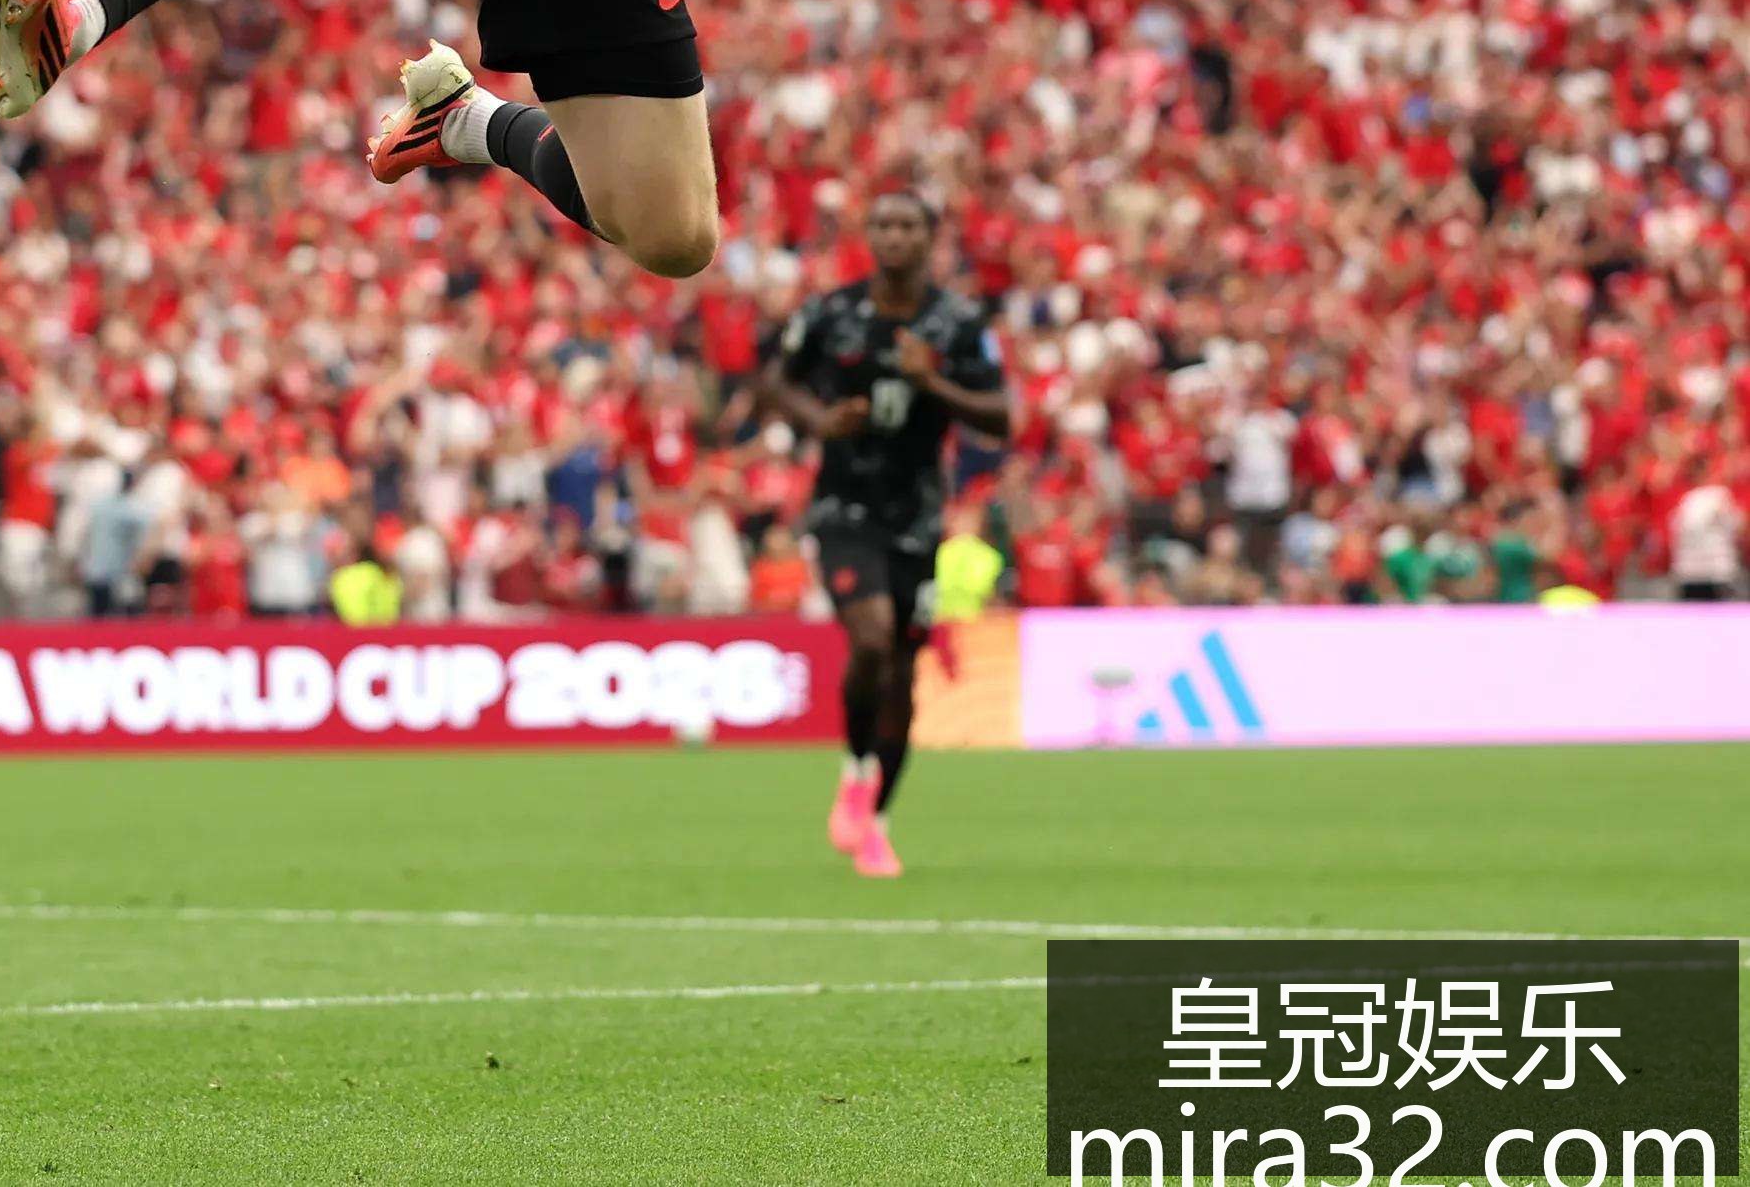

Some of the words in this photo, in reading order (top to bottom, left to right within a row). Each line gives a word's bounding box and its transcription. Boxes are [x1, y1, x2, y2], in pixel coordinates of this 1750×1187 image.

[29, 646, 336, 734] WORLD
[337, 643, 505, 733] CUP
[505, 641, 789, 730] 2026
